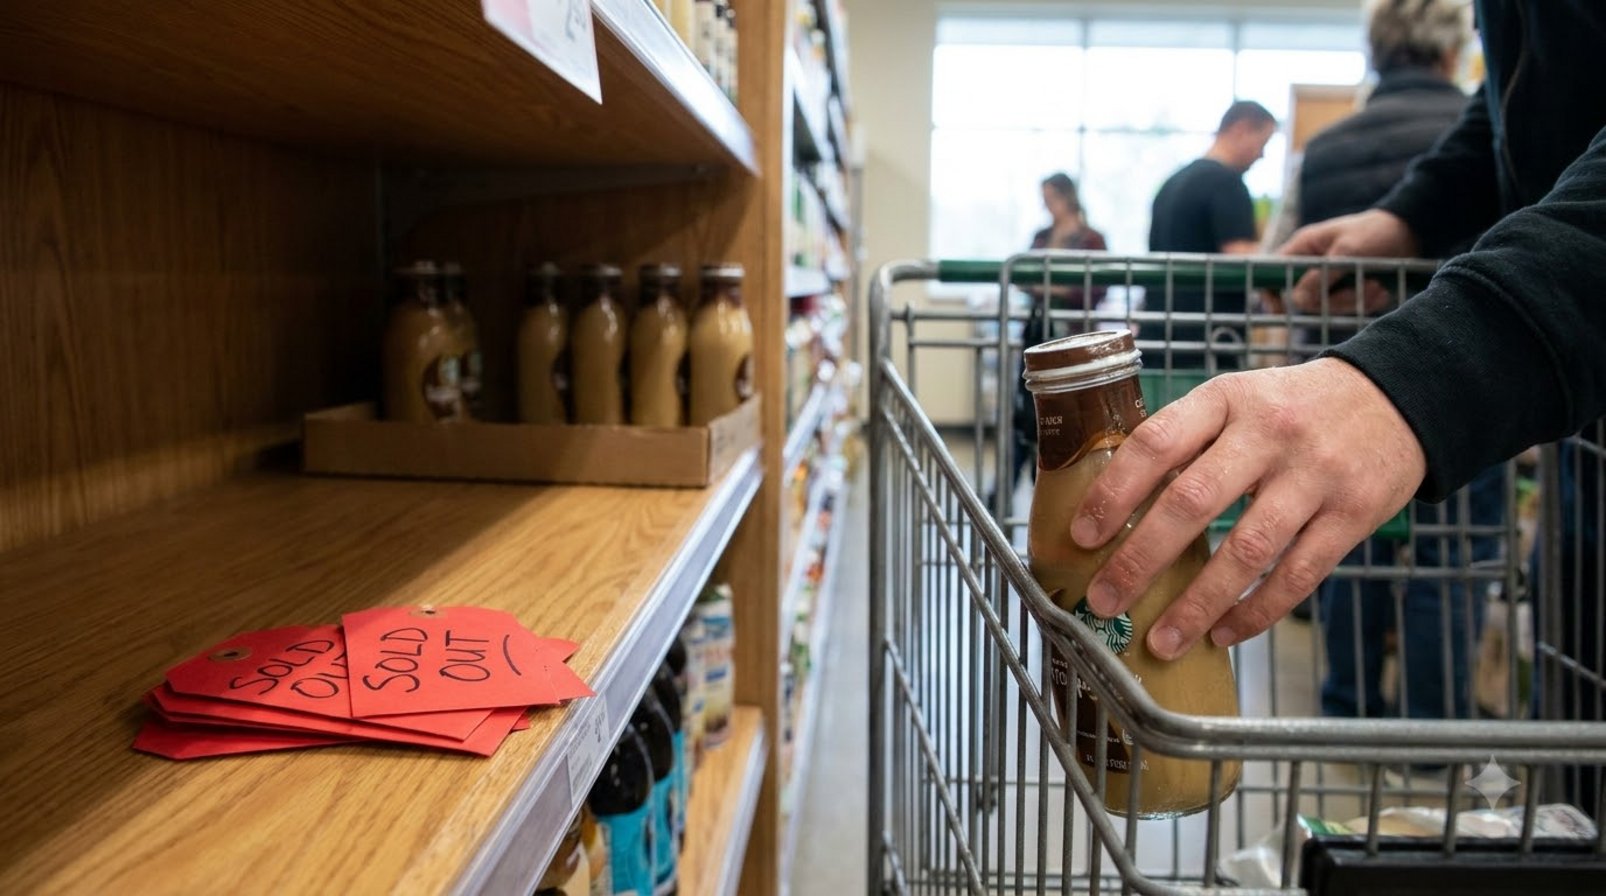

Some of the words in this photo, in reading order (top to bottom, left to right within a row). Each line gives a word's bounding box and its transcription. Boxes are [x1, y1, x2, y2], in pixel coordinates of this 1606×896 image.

[229, 639, 335, 695] SOLD
[362, 627, 429, 693] SOLD
[438, 629, 491, 682] OUT
